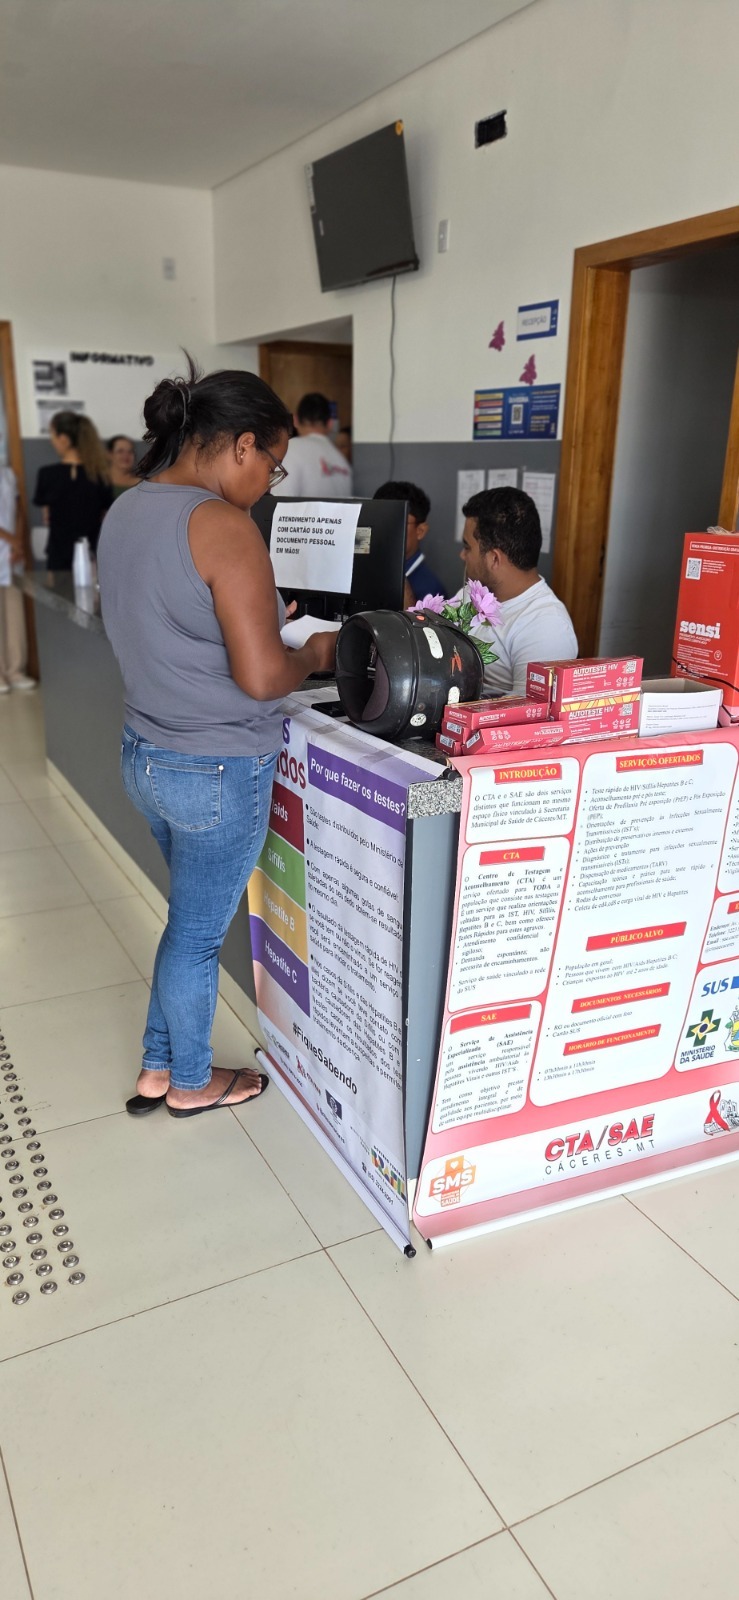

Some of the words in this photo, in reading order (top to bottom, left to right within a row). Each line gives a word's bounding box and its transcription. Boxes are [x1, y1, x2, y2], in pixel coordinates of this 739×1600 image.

[70, 351, 154, 366] INFORMATIVO
[317, 517, 342, 525] APENAS
[309, 538, 335, 546] PESSOAL
[680, 620, 720, 639] sensi
[574, 665, 607, 676] AUTOTESTE
[569, 708, 603, 719] AUTOTESTE
[619, 758, 657, 768] SERVIÇOS
[658, 754, 700, 765] OFERTADOS
[499, 767, 557, 780] INTRODUÇÃO
[311, 758, 323, 774] Por
[324, 768, 339, 782] que
[341, 772, 360, 793] fazer
[362, 788, 371, 799] os
[374, 790, 406, 817] testes?
[551, 788, 572, 796] serviços
[605, 786, 622, 794] rápido
[588, 804, 605, 812] Oferta
[613, 802, 638, 810] Profilaxia
[649, 798, 671, 806] exposição
[702, 791, 726, 799] Exposição
[590, 794, 631, 803] Aconselhamento
[474, 803, 496, 811] distintos
[499, 802, 509, 810] que
[510, 808, 536, 816] vinculado
[471, 820, 499, 829] Municipal
[508, 817, 524, 825] Saúde
[586, 820, 615, 829] Orientações
[631, 816, 654, 825] prevenção
[694, 808, 723, 816] Sexualmente
[359, 835, 370, 848] pelo
[371, 841, 397, 864] Ministério
[503, 852, 520, 860] CTA
[268, 847, 286, 873] Sífilis
[313, 842, 334, 860] testagem
[353, 866, 369, 884] segura
[369, 879, 373, 887] e
[478, 872, 498, 880] Centro
[525, 868, 551, 876] Testagem
[311, 862, 320, 874] Com
[361, 897, 375, 911] gotas
[377, 905, 385, 917] de
[464, 880, 510, 891] Aconselhamento
[462, 891, 480, 900] serviço
[486, 888, 509, 896] ofertado
[514, 886, 526, 894] para
[575, 895, 591, 904] Rodas
[461, 898, 488, 909] população
[500, 894, 522, 902] consiste
[475, 905, 495, 915] serviço
[528, 899, 558, 908] orientações
[574, 904, 591, 912] Coleta
[264, 893, 289, 925] Hepatite
[290, 917, 295, 931] B
[316, 907, 337, 928] resultado
[381, 955, 388, 965] de
[473, 929, 495, 939] Rápidos
[496, 927, 508, 936] para
[610, 932, 643, 944] PÚBLICO
[644, 929, 663, 938] ALVO
[463, 937, 496, 948] Atendimento
[265, 940, 291, 976] Hepatite
[292, 970, 297, 984] C
[370, 971, 378, 983] um
[380, 978, 399, 998] serviço
[701, 978, 729, 997] SUS
[580, 996, 622, 1008] DOCUMENTOS
[623, 988, 662, 999] NECESSÁRIOS
[481, 1013, 497, 1022] SAE
[571, 1017, 596, 1028] documento
[378, 1034, 385, 1043] ou
[460, 1039, 480, 1048] Serviço
[504, 1030, 533, 1039] Assistência
[496, 1040, 513, 1048] (SAE)
[568, 1039, 596, 1051] HORÁRIO
[606, 1029, 655, 1043] FUNCIONAMENTO
[468, 1052, 486, 1061] serviço
[680, 1057, 690, 1065] DA
[691, 1051, 714, 1063] SAÚDE
[681, 1044, 716, 1058] MINISTÉRIO
[292, 1022, 358, 1095] #FiqueSabendo
[544, 1113, 655, 1163] CTA/SAE
[433, 1169, 472, 1194] SMS
